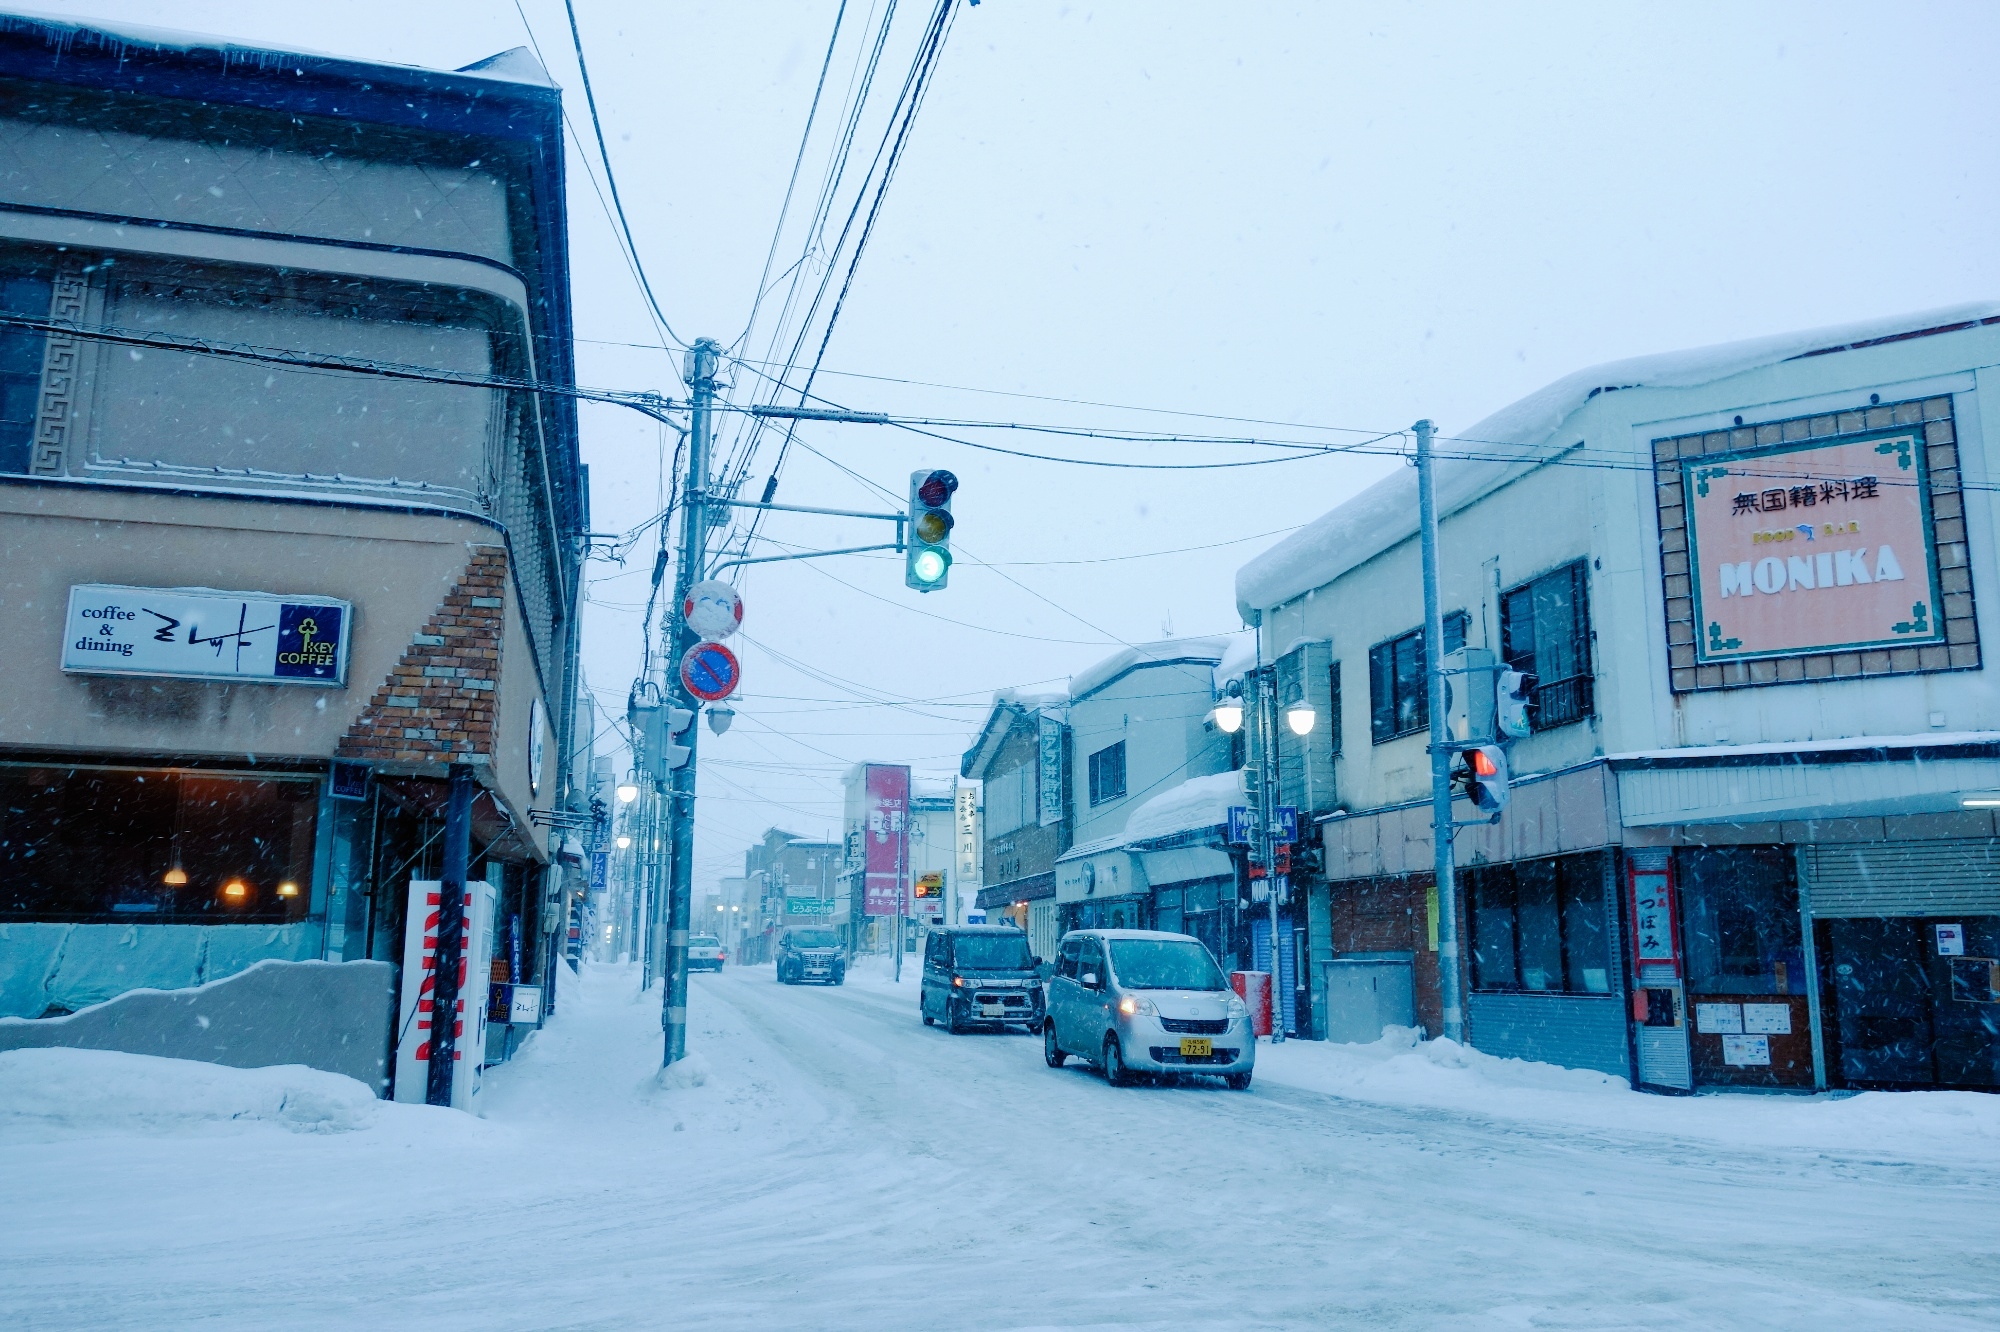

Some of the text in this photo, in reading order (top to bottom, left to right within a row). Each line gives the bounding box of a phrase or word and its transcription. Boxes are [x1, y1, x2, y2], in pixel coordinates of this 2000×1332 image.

[1732, 476, 1880, 516] 無国籍料理
[1752, 519, 1861, 546] FOOD BAR
[1720, 544, 1905, 599] MONIKA
[81, 605, 136, 621] coffee
[99, 623, 115, 636] &
[75, 636, 135, 657] dining
[310, 642, 336, 654] KEY
[278, 652, 334, 666] COFFEE
[335, 785, 363, 795] COFFEE
[1639, 898, 1660, 950] つぼみ
[1187, 1045, 1209, 1055] 72-91
